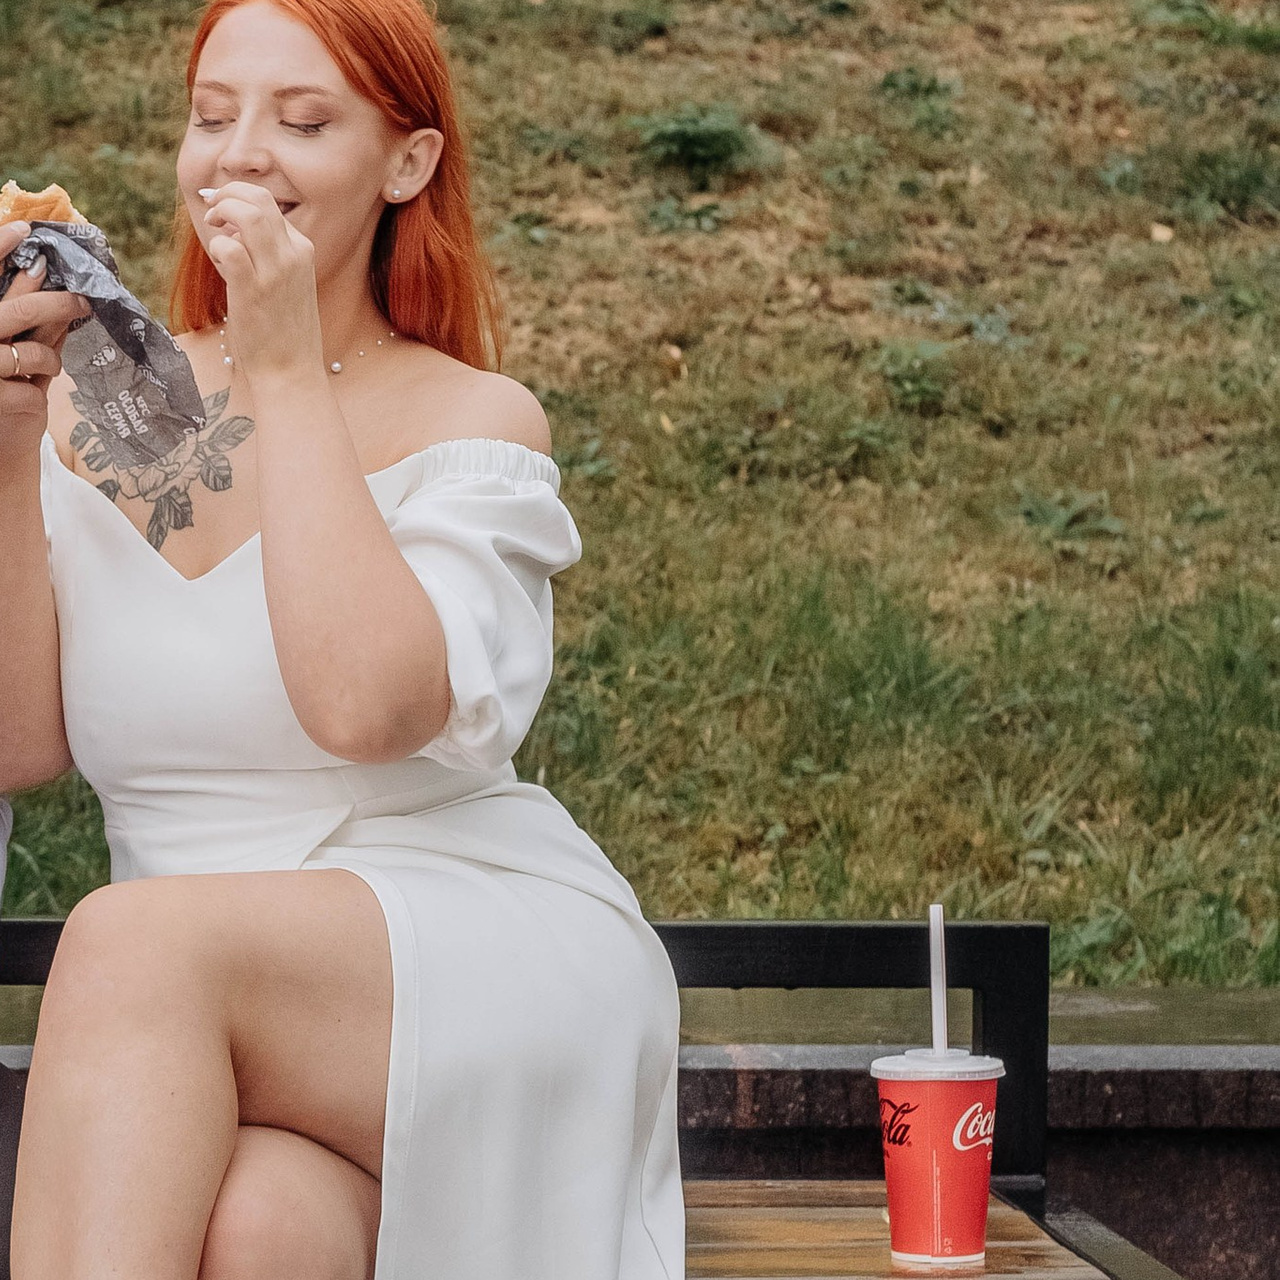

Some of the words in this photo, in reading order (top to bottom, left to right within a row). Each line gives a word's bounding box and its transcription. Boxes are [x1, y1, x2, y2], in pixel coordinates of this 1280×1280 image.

[103, 401, 132, 439] СЕРИЯ
[118, 389, 149, 435] ОСОБАЯ
[135, 395, 151, 417] KFC
